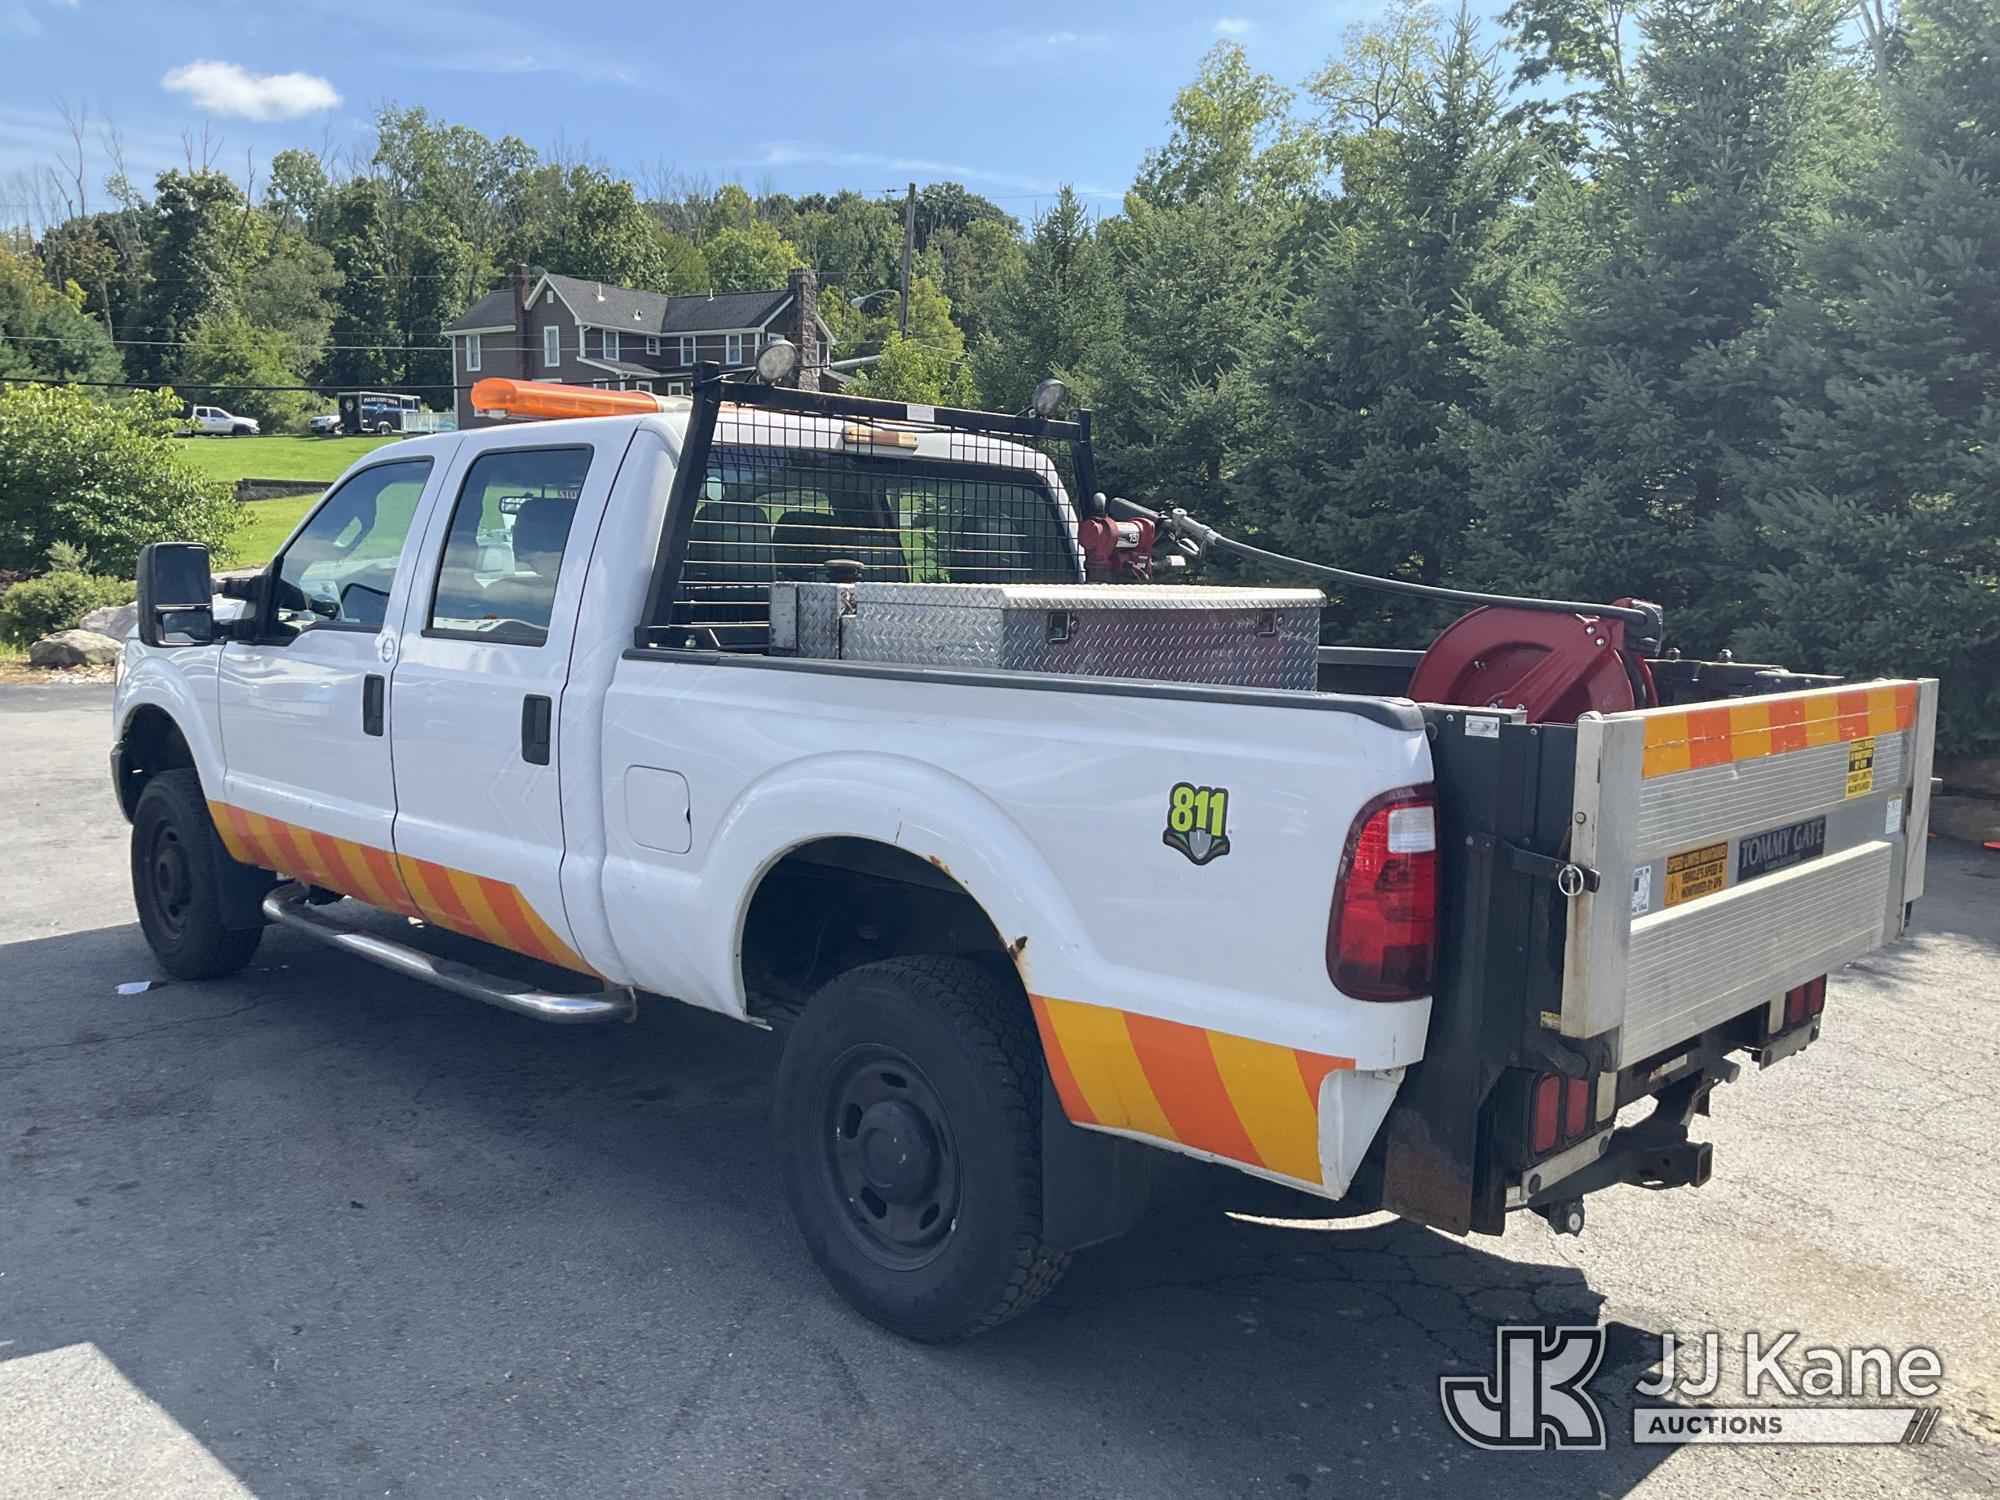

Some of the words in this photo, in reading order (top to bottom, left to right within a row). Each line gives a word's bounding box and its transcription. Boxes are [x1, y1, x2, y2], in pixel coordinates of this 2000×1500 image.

[1170, 785, 1226, 837] 811
[1742, 828, 1792, 868] TOMMY
[1793, 820, 1825, 851] GATE
[1668, 855, 1684, 873] SPEED
[1713, 876, 1722, 889] GPS
